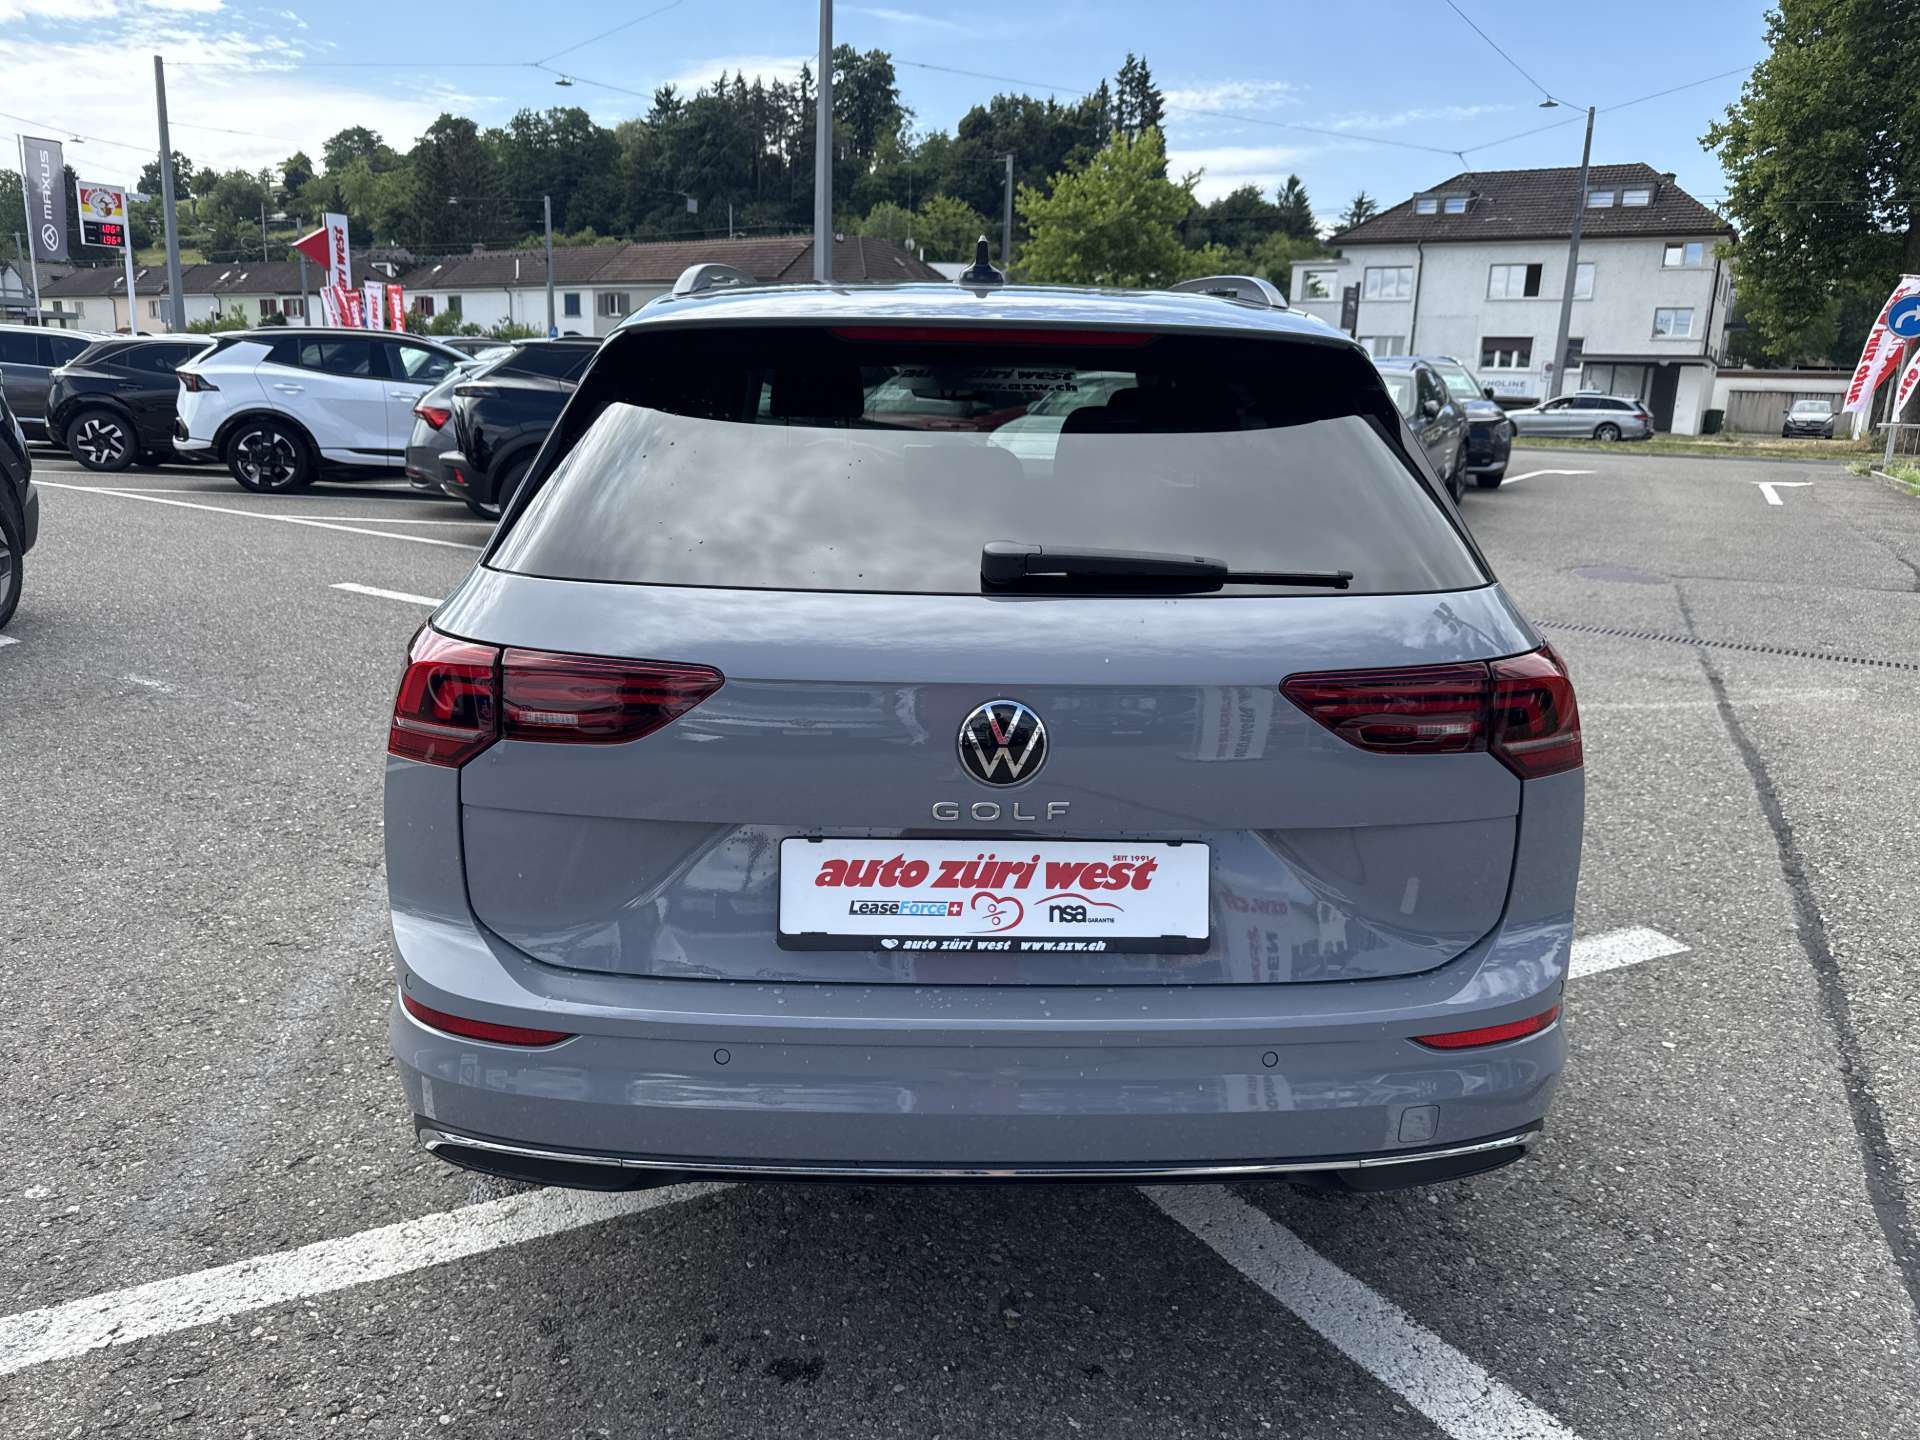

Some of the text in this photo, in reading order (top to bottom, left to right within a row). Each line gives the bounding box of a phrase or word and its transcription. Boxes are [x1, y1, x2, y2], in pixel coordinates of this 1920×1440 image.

[40, 149, 53, 220] MAXUS
[932, 801, 1070, 821] GOLF
[815, 853, 1158, 891] auto züri west
[849, 900, 947, 916] LeaseForce
[1049, 904, 1087, 923] nsa
[903, 939, 1107, 951] auto züri west www.azw.ch
